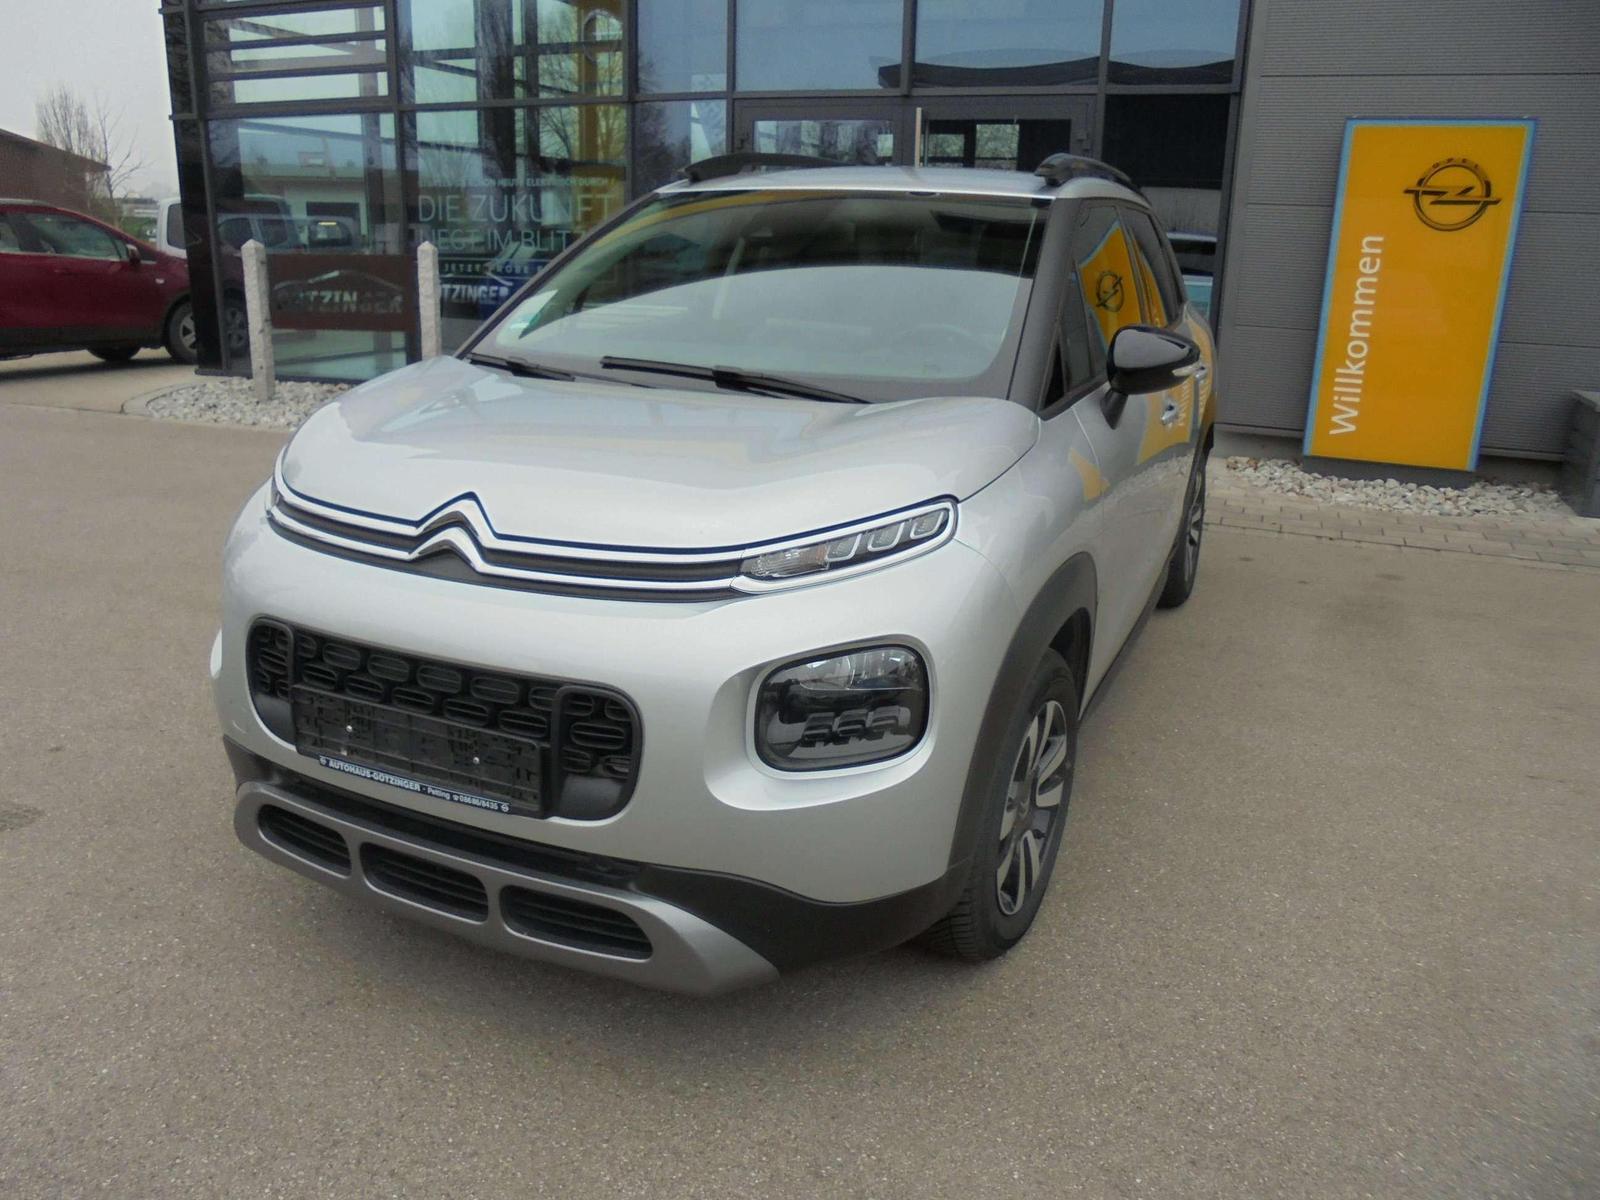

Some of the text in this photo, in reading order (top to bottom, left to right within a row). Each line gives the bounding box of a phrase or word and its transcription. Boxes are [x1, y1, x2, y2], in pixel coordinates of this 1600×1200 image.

[418, 194, 615, 223] DIE ZUKUNFT
[486, 229, 513, 251] IM
[1328, 234, 1385, 436] Willkommen
